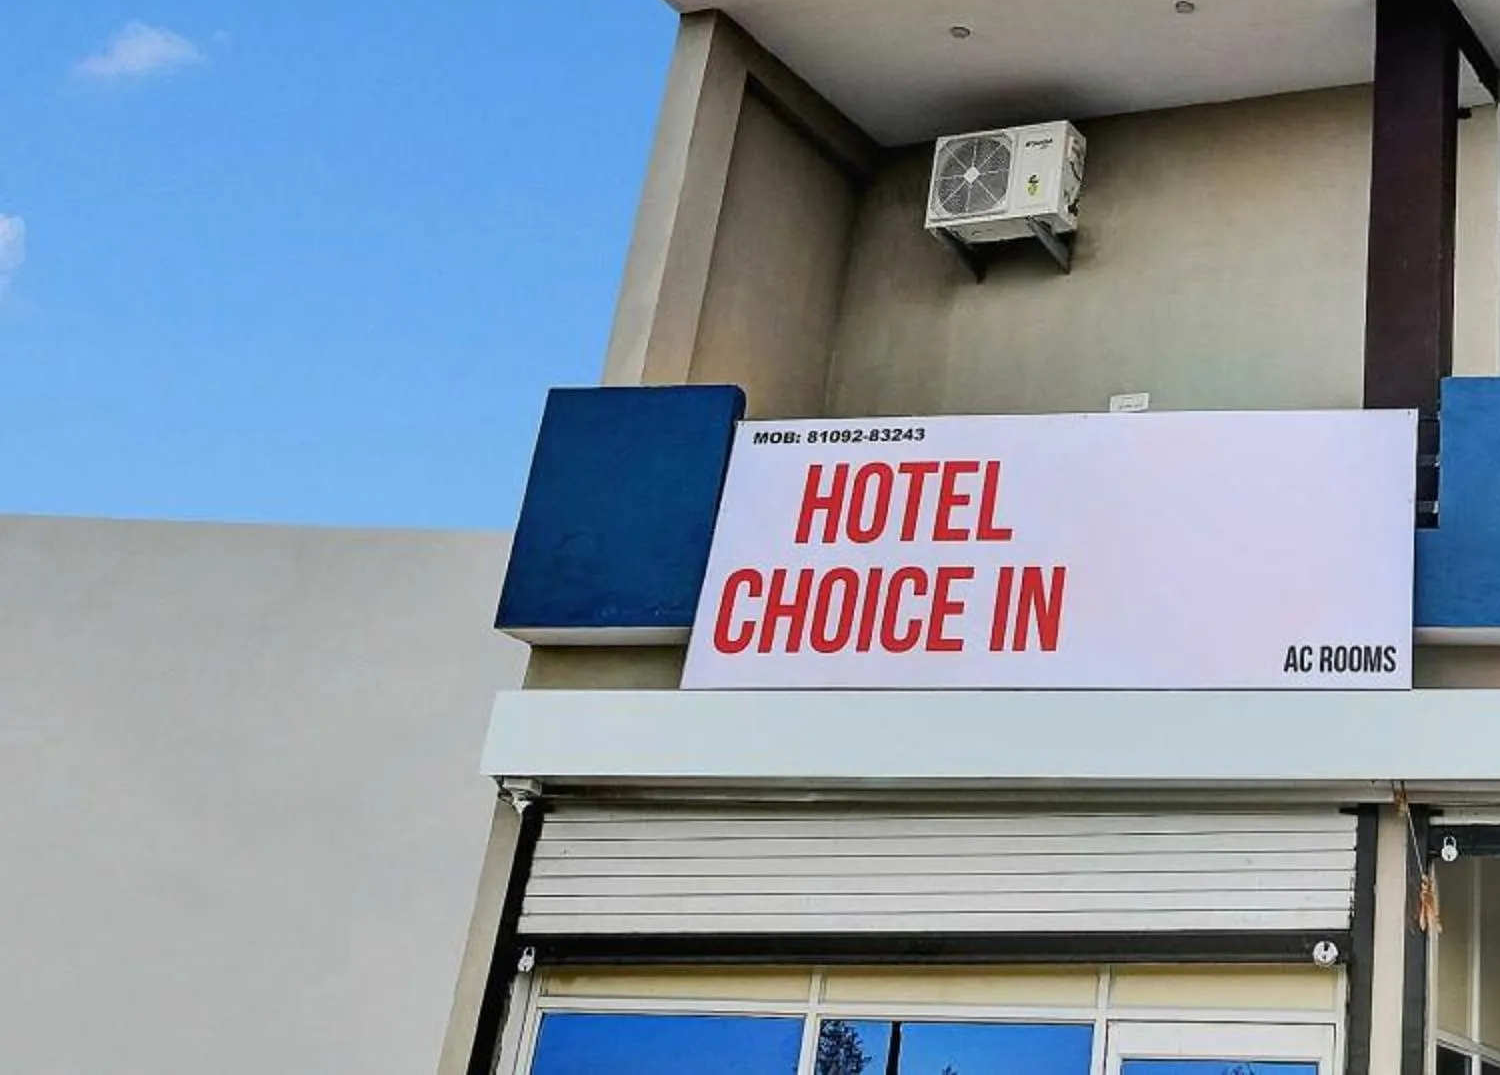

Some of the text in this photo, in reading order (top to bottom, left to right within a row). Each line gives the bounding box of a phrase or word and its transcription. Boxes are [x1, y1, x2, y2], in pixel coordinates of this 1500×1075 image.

[753, 427, 926, 445] MOB: 81092-83243
[794, 460, 1013, 545] HOTEL
[713, 564, 1067, 655] CHOICE IN
[1283, 644, 1397, 674] AC ROOMS
